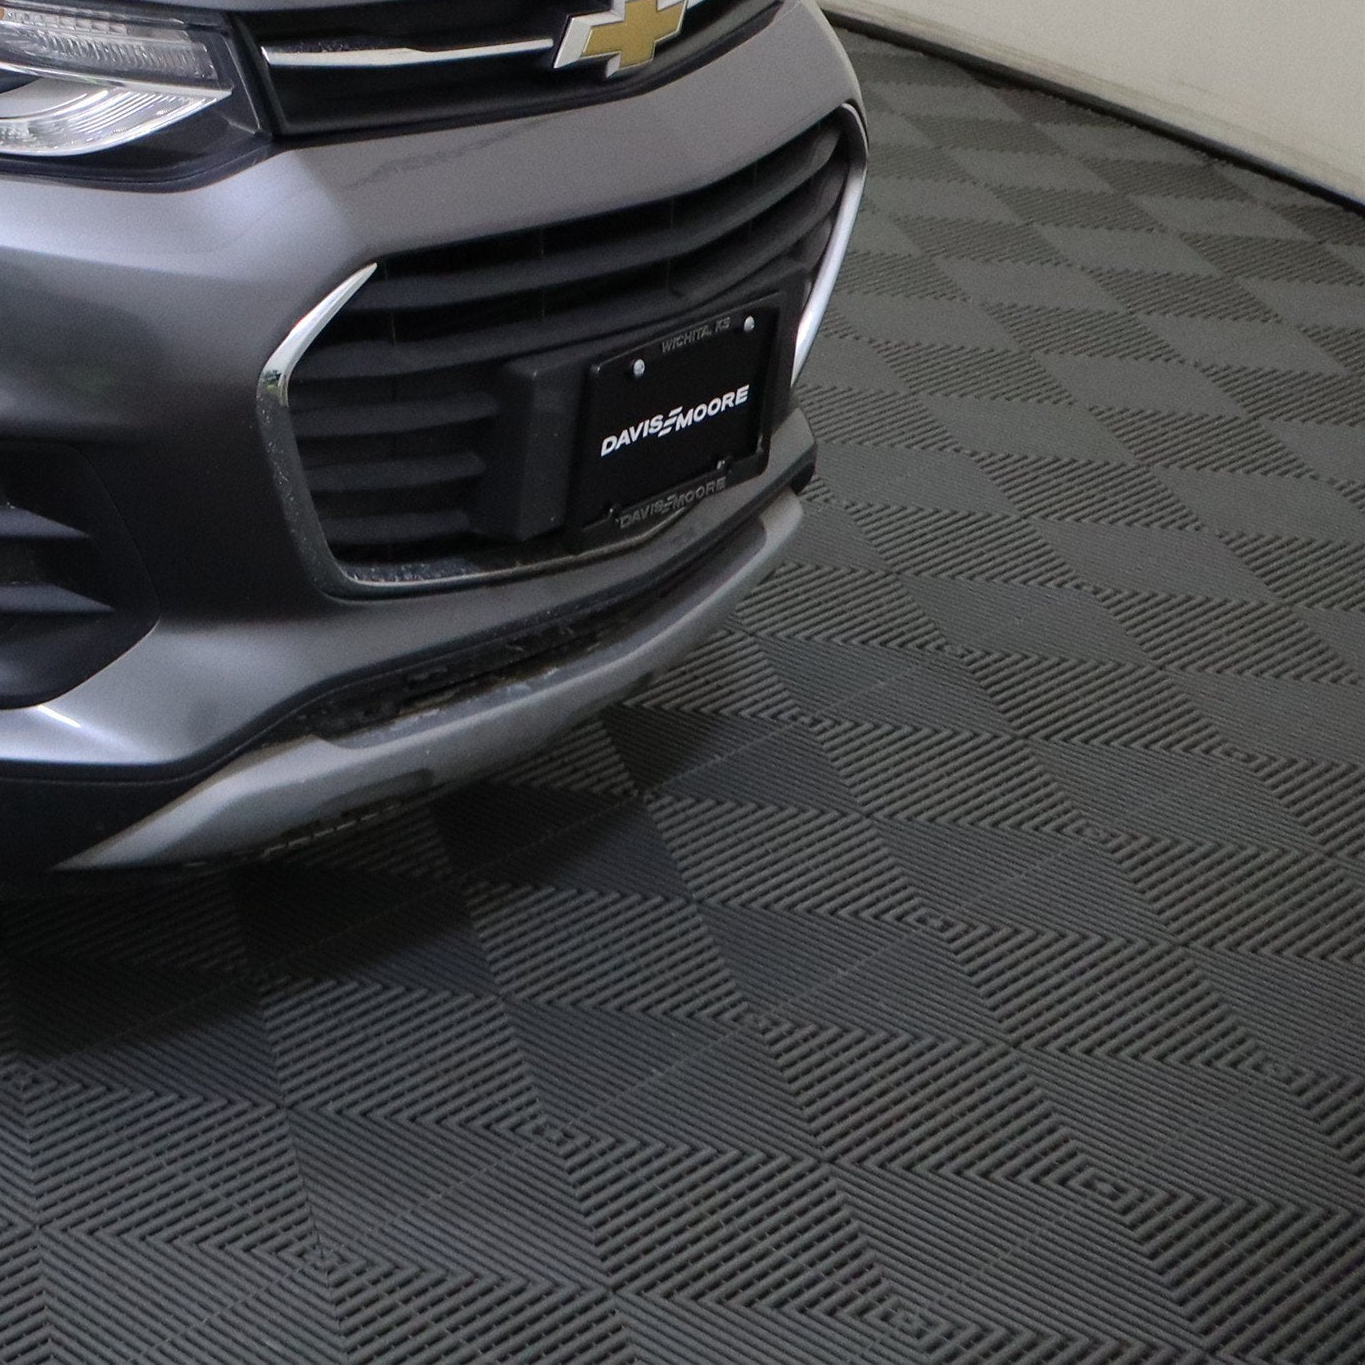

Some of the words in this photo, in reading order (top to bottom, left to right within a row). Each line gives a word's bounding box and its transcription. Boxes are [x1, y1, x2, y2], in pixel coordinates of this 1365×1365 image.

[600, 413, 665, 458] DAVIS
[674, 384, 750, 432] MOORE
[619, 499, 665, 530] DAVIS
[673, 477, 727, 509] MOORE
